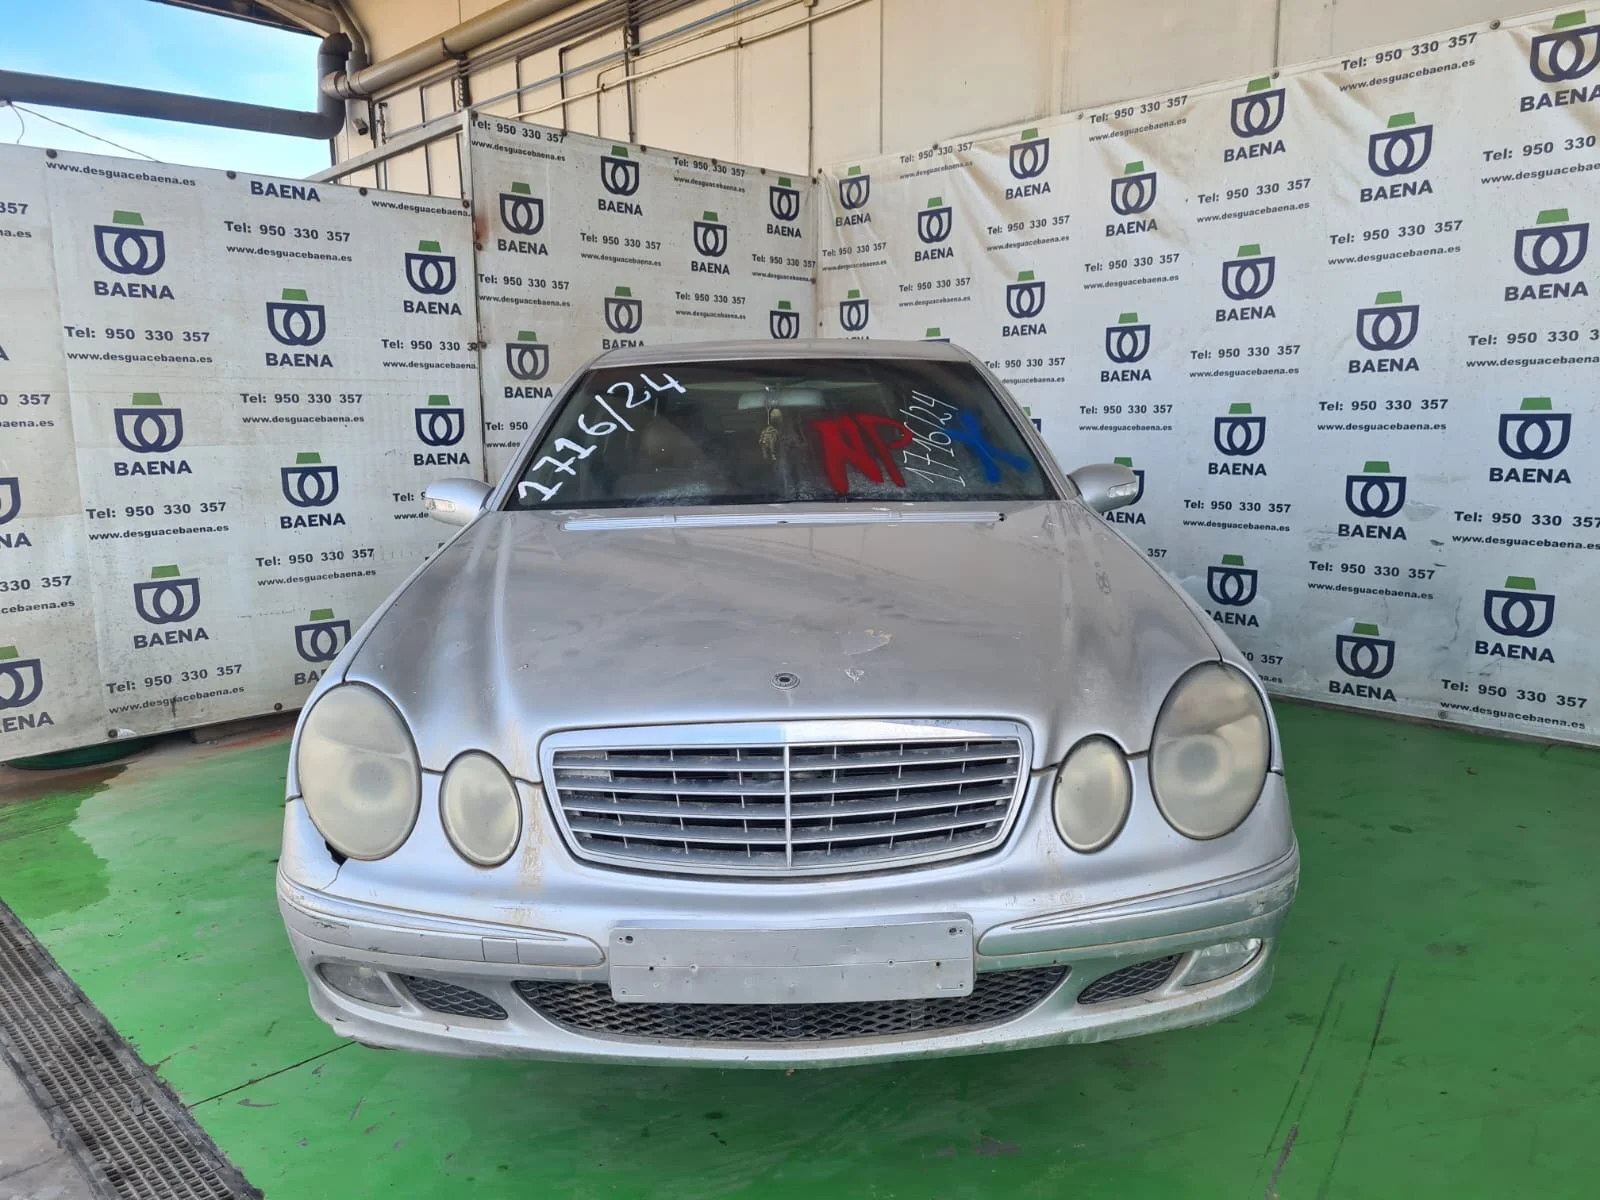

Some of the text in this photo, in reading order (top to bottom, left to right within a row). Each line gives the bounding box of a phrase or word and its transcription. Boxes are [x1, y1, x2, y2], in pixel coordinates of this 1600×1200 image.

[1341, 32, 1477, 70] Tel: 950 330 357
[1339, 59, 1475, 92] www.desguacebaena.es
[1520, 84, 1600, 112] BAENA
[1090, 95, 1187, 124] Tel: 950 330 357
[1089, 118, 1186, 142] www.desguacebaena.es
[1224, 140, 1286, 162] BAENA
[1483, 135, 1596, 161] Tel: 950 330
[46, 162, 196, 186] www.desguacebaena.es
[251, 181, 320, 202] BAENA
[1005, 182, 1051, 200] BAENA
[1197, 178, 1311, 204] Tel: 950 330 357
[1360, 179, 1433, 202] BAENA
[598, 198, 643, 216] BAENA
[1197, 202, 1309, 223] www.desguacebaena.es
[836, 212, 871, 227] BAENA
[987, 215, 1070, 235] Tel: 950 330 357
[1106, 218, 1158, 237] BAENA
[224, 221, 350, 242] Tel: 950 330 357
[767, 223, 801, 238] BAENA
[1329, 220, 1463, 244] Tel: 950 330 357
[497, 238, 548, 256] BAENA
[580, 232, 661, 250] Tel: 950 330 357
[226, 246, 352, 262] www.desguacebaena.es
[915, 247, 953, 262] BAENA
[1328, 246, 1461, 265] www.desguacebaena.es
[691, 261, 730, 275] BAENA
[1084, 253, 1179, 272] Tel: 950 330 357
[479, 274, 569, 290] Tel: 950 330 357
[899, 277, 970, 292] Tel: 950 330 357
[94, 281, 174, 300] BAENA
[1504, 281, 1588, 301] BAENA
[403, 300, 462, 315] BAENA
[1216, 305, 1275, 322] BAENA
[64, 326, 209, 342] Tel: 950 330 357
[1003, 323, 1046, 337] BAENA
[1468, 330, 1579, 346] Tel: 950 330
[381, 339, 460, 351] Tel: 950 330
[1190, 345, 1300, 359] Tel: 950 330 357
[67, 352, 212, 363] www.desguacebaena.es
[266, 352, 333, 367] BAENA
[1348, 357, 1419, 373] BAENA
[1101, 369, 1151, 382] BAENA
[1189, 368, 1299, 378] www.desguacebaena.es
[240, 393, 362, 403] Tel: 950 330 357
[504, 386, 553, 398] BAENA
[1080, 404, 1172, 414] Tel: 950 330 357
[1319, 399, 1448, 411] Tel: 950 330 357
[242, 415, 364, 424] www.desguacebaena.es
[1317, 422, 1446, 432] www.desguacebaena.es
[414, 452, 470, 466] BAENA
[114, 460, 192, 476] BAENA
[1208, 462, 1267, 476] BAENA
[1489, 467, 1571, 483] BAENA
[86, 502, 226, 519] Tel: 950 330 357
[1184, 499, 1291, 513] Tel: 950 330 357
[280, 513, 345, 529] BAENA
[1183, 520, 1290, 531] www.desguacebaena.es
[1454, 511, 1482, 522] Tel:
[1492, 513, 1521, 524] 950
[1532, 514, 1562, 526] 330
[89, 525, 229, 540] www.desguacebaena.es
[1338, 524, 1406, 540] BAENA
[255, 548, 374, 567] Tel: 950 330 357
[257, 570, 376, 586] www.desguacebaena.es
[1309, 561, 1435, 579] Tel: 950 330 357
[1308, 583, 1433, 599] www.desguacebaena.es
[134, 627, 209, 649] BAENA
[1475, 640, 1554, 663] BAENA
[106, 664, 242, 694] Tel: 950 330 357
[1329, 680, 1396, 702] BAENA
[1441, 679, 1587, 708] Tel: 950 330 357
[1440, 702, 1585, 729] www.desguacebaena.es
